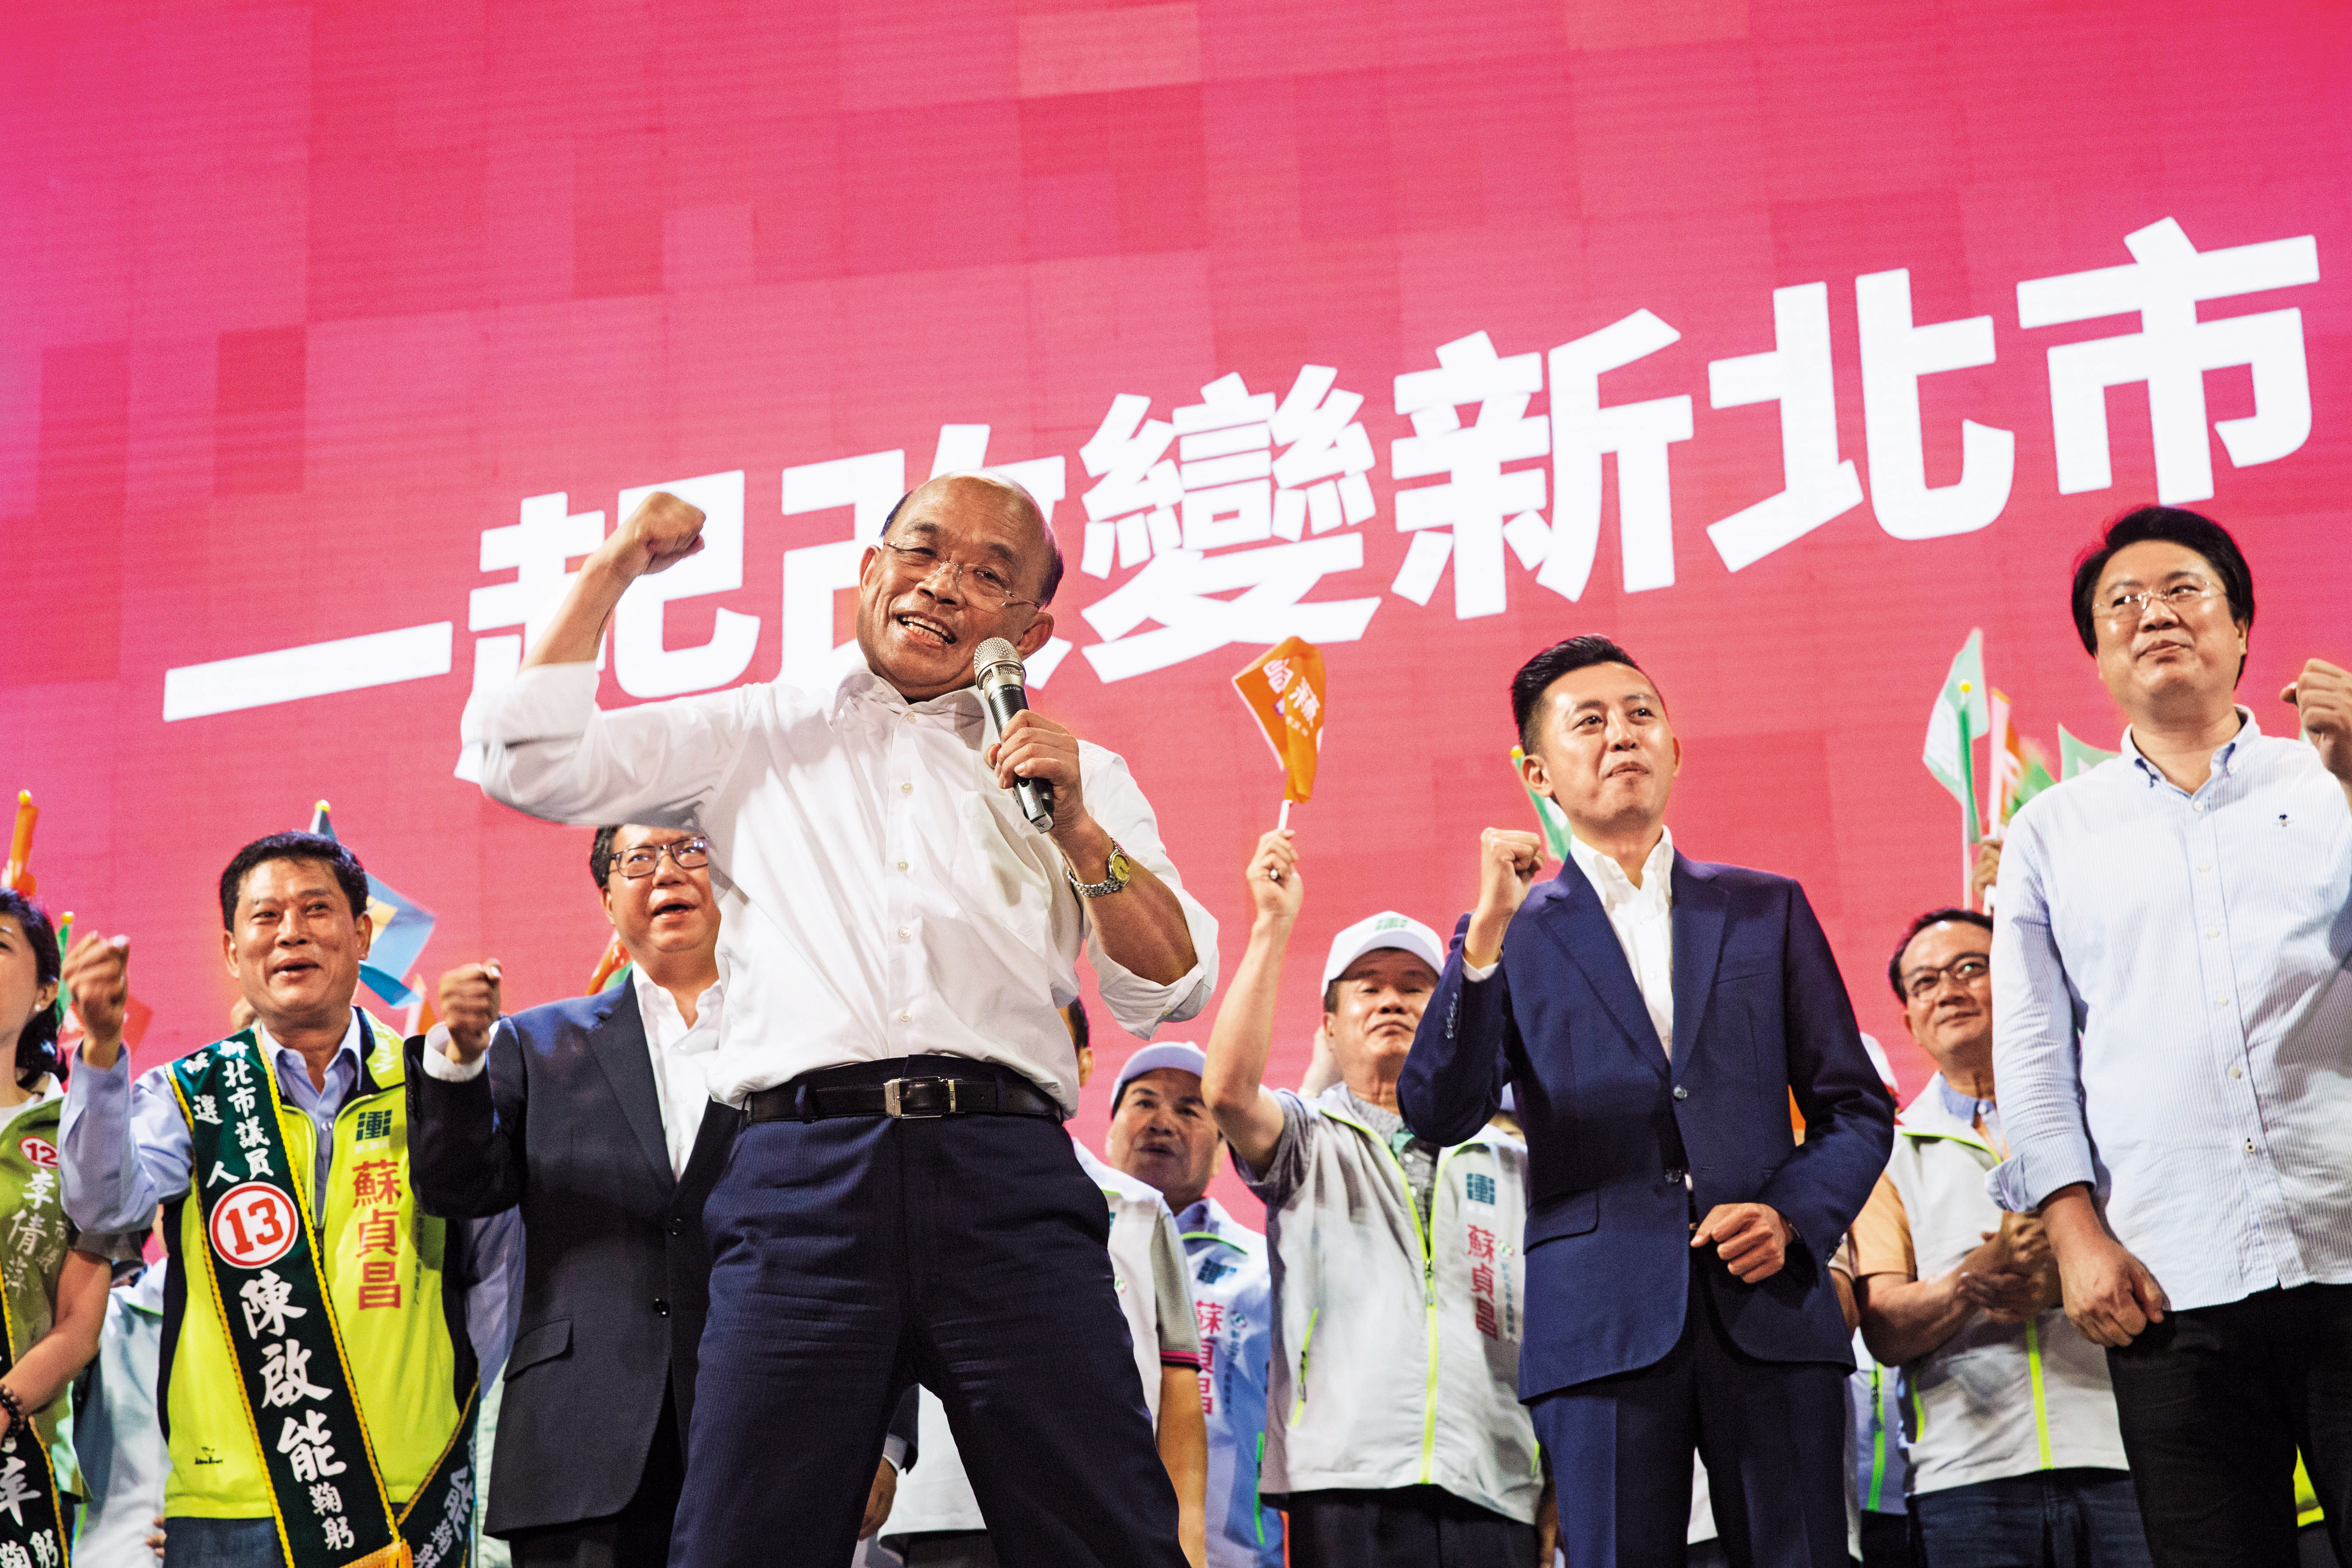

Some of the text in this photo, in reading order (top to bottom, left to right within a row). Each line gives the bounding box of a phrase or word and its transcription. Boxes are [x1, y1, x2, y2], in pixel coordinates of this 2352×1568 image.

[26, 1142, 59, 1166] 12
[217, 1040, 275, 1181] 新北市議員
[225, 1198, 285, 1255] 13
[351, 1159, 402, 1310] 蘇貞昌
[1467, 1224, 1499, 1341] 蘇貞昌
